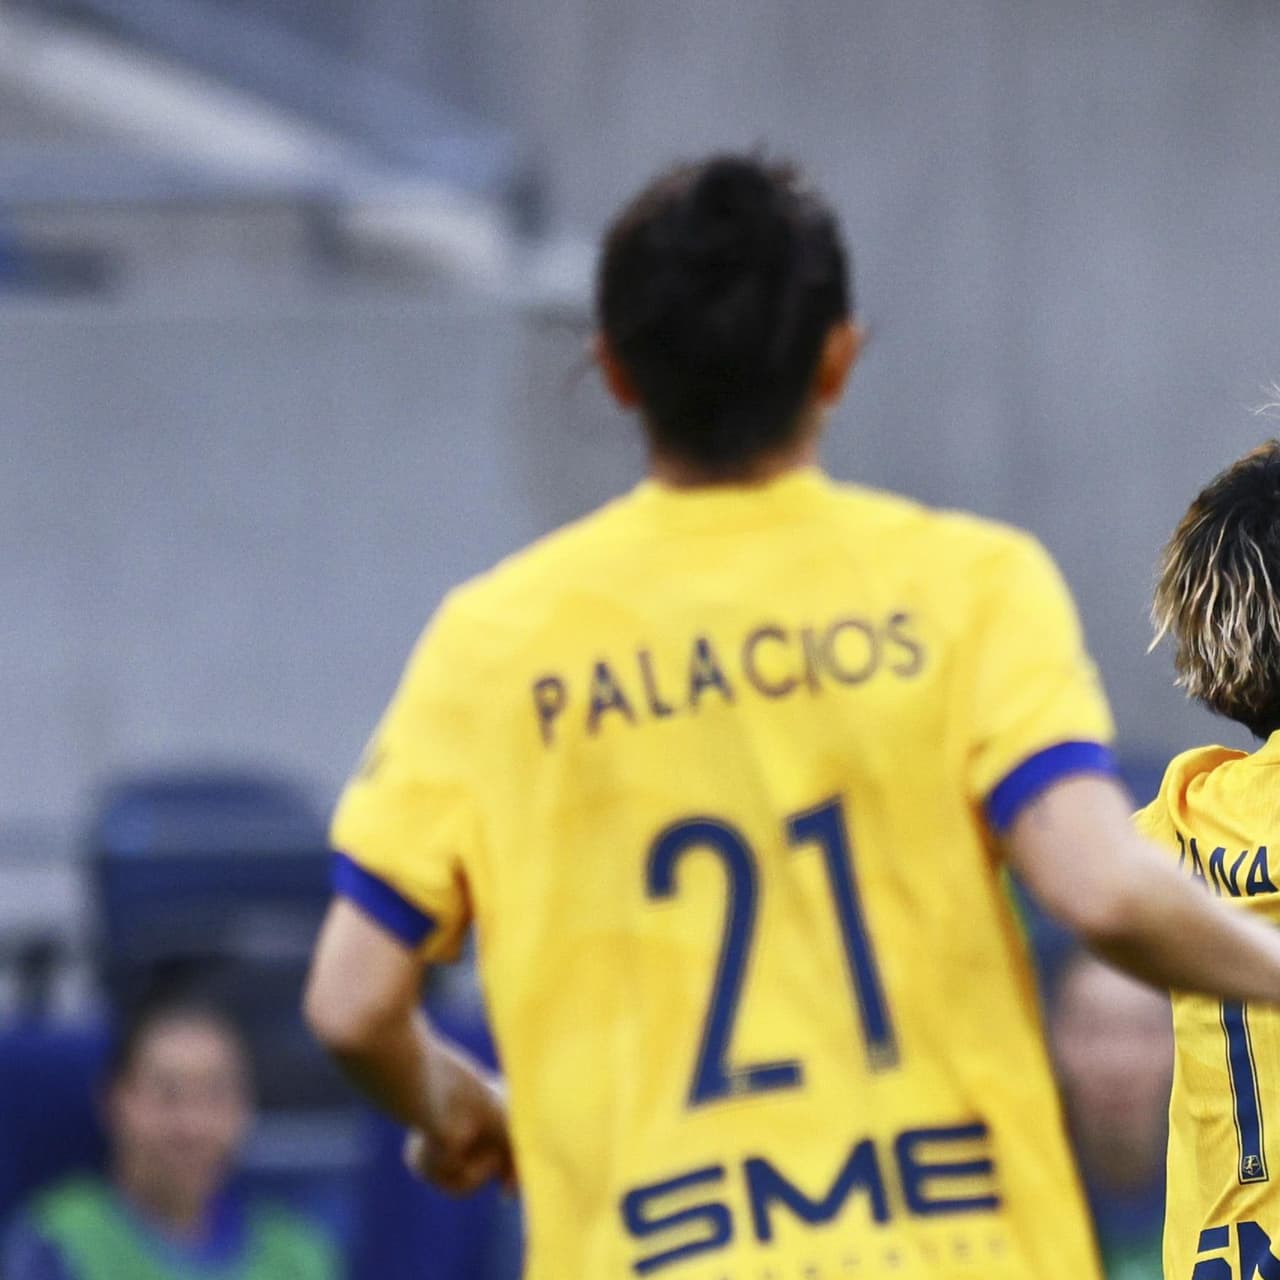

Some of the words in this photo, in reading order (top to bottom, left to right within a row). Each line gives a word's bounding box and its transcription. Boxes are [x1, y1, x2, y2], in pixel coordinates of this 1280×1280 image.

[531, 612, 925, 748] PALACIOS
[643, 790, 901, 1112] 21
[620, 1122, 1003, 1277] SME
